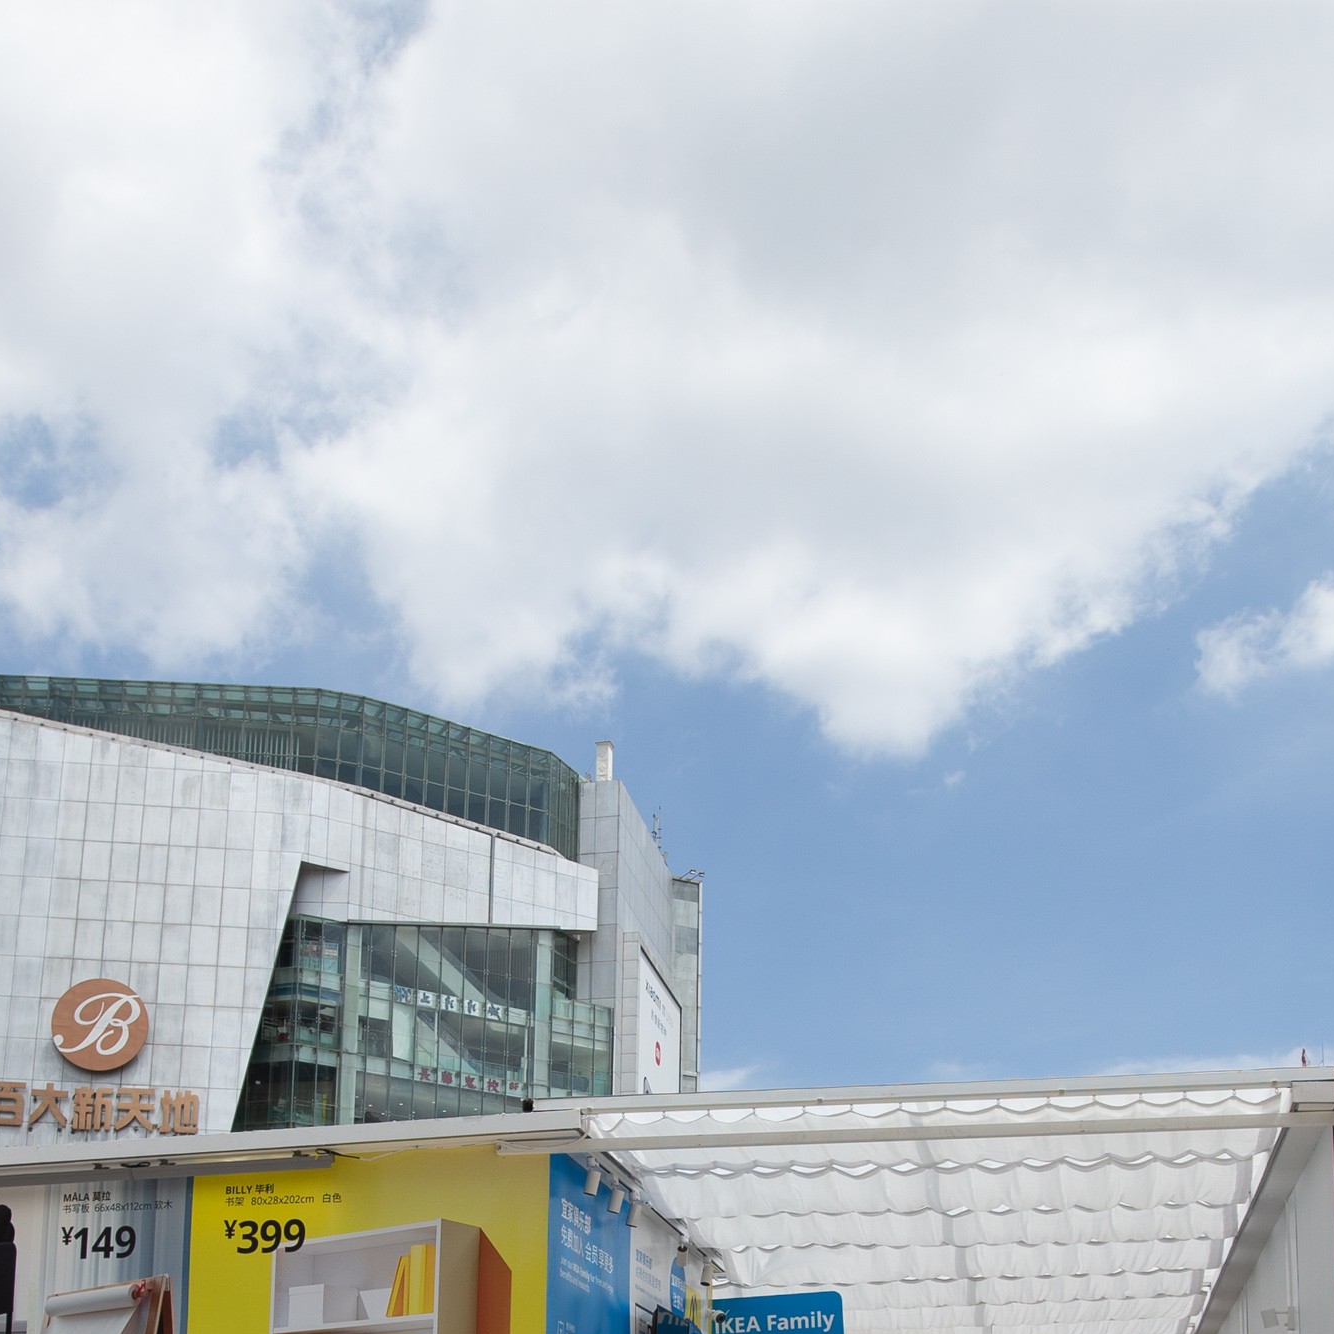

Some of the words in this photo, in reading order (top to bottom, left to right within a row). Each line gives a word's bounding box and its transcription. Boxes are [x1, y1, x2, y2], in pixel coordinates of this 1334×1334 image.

[225, 1185, 253, 1196] BILLY
[255, 1183, 275, 1195] 毕利
[62, 1203, 90, 1214] 书写板
[154, 1200, 173, 1211] 软木
[225, 1196, 245, 1207] 书架
[251, 1194, 315, 1206] 80x28x202cm
[322, 1192, 343, 1204] 白色
[61, 1225, 136, 1260] ¥149
[224, 1219, 306, 1255] ¥399
[715, 1316, 761, 1334] IKEA
[767, 1311, 835, 1332] Family
